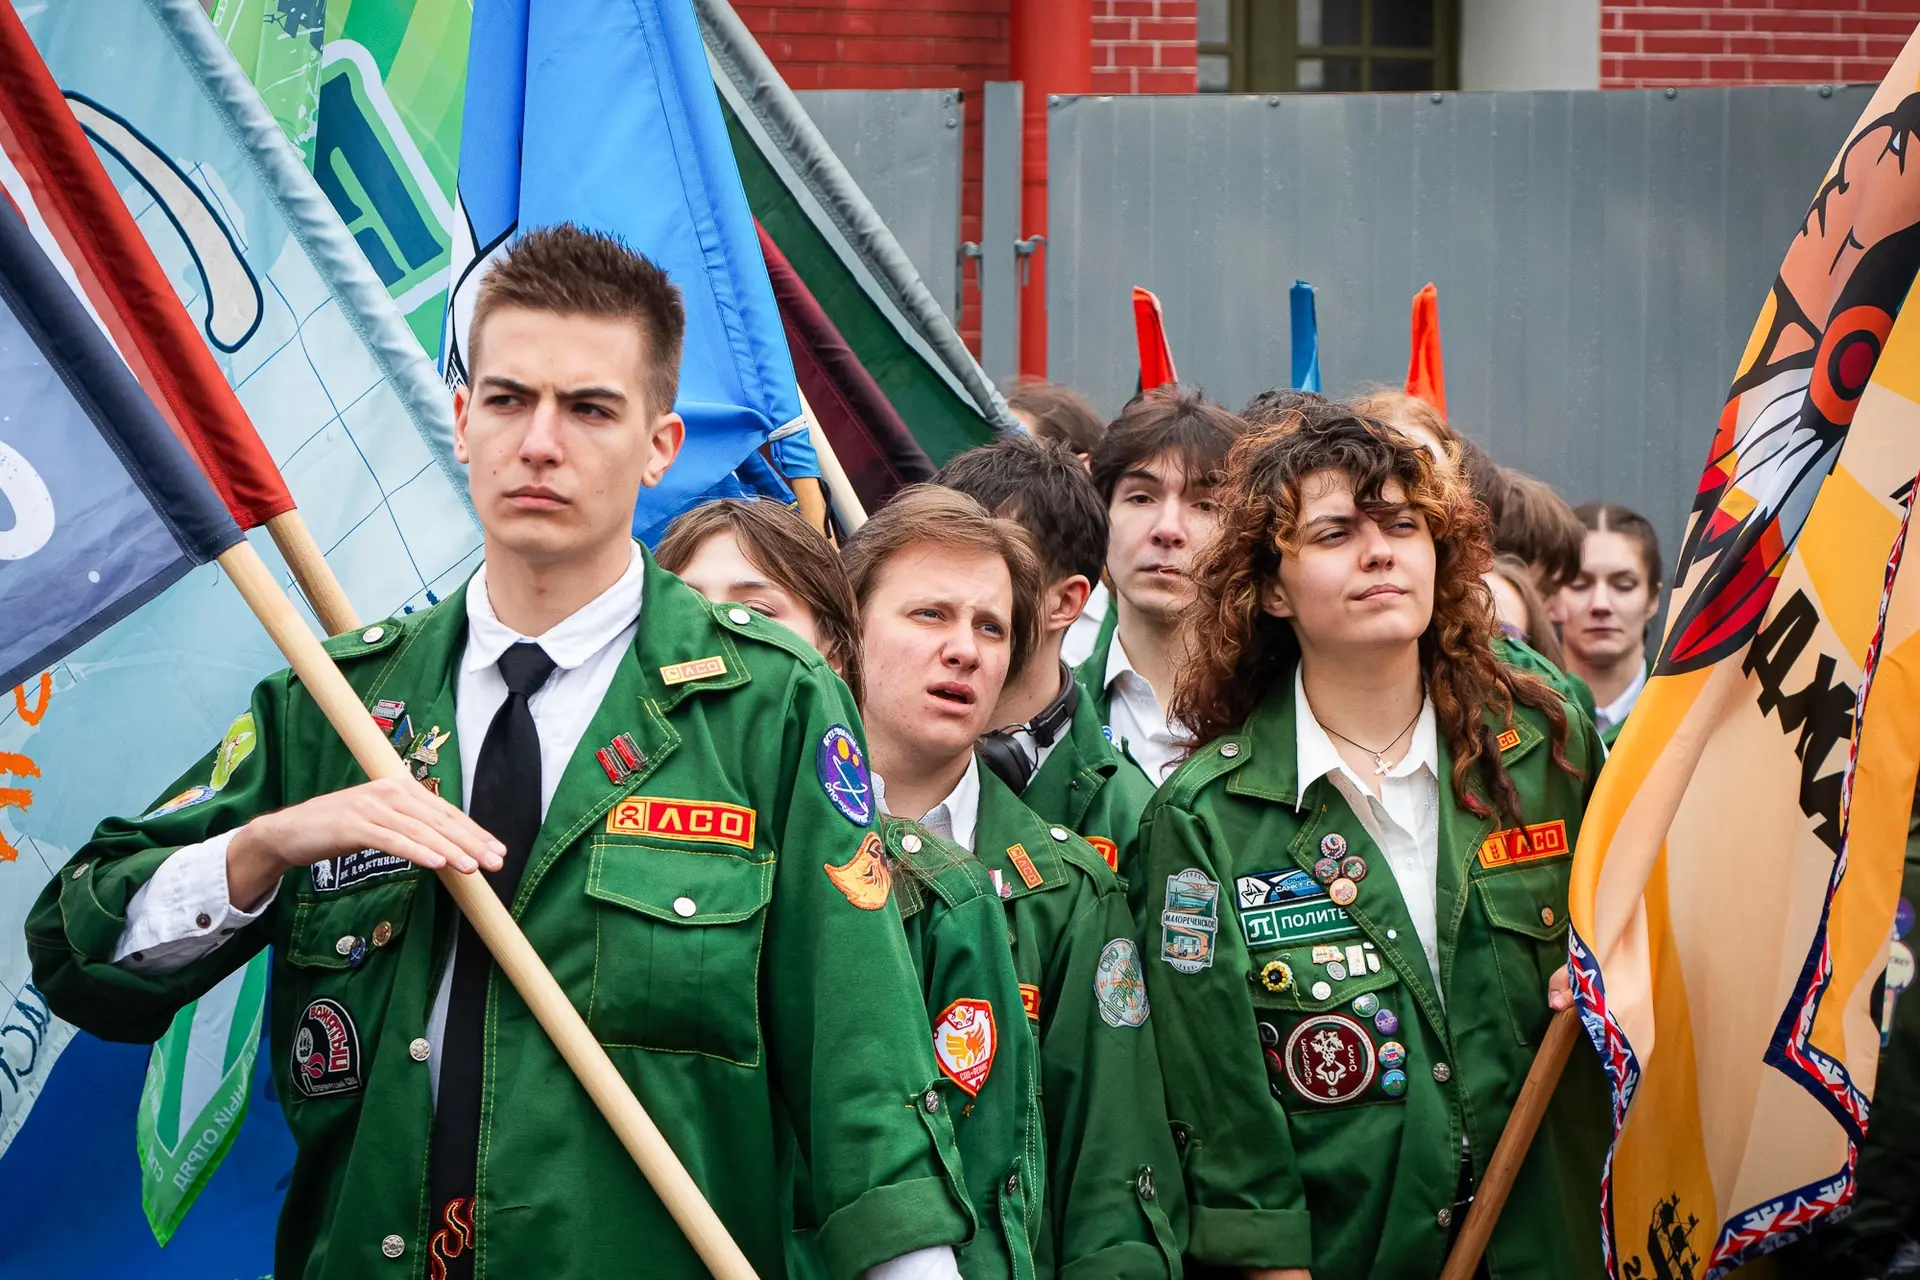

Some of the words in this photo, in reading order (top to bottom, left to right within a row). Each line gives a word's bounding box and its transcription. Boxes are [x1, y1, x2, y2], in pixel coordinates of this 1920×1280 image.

[1499, 733, 1516, 746] СО
[657, 807, 744, 836] ЛСО
[1165, 914, 1216, 929] МАЛОРЕЧЕНСКОЕ
